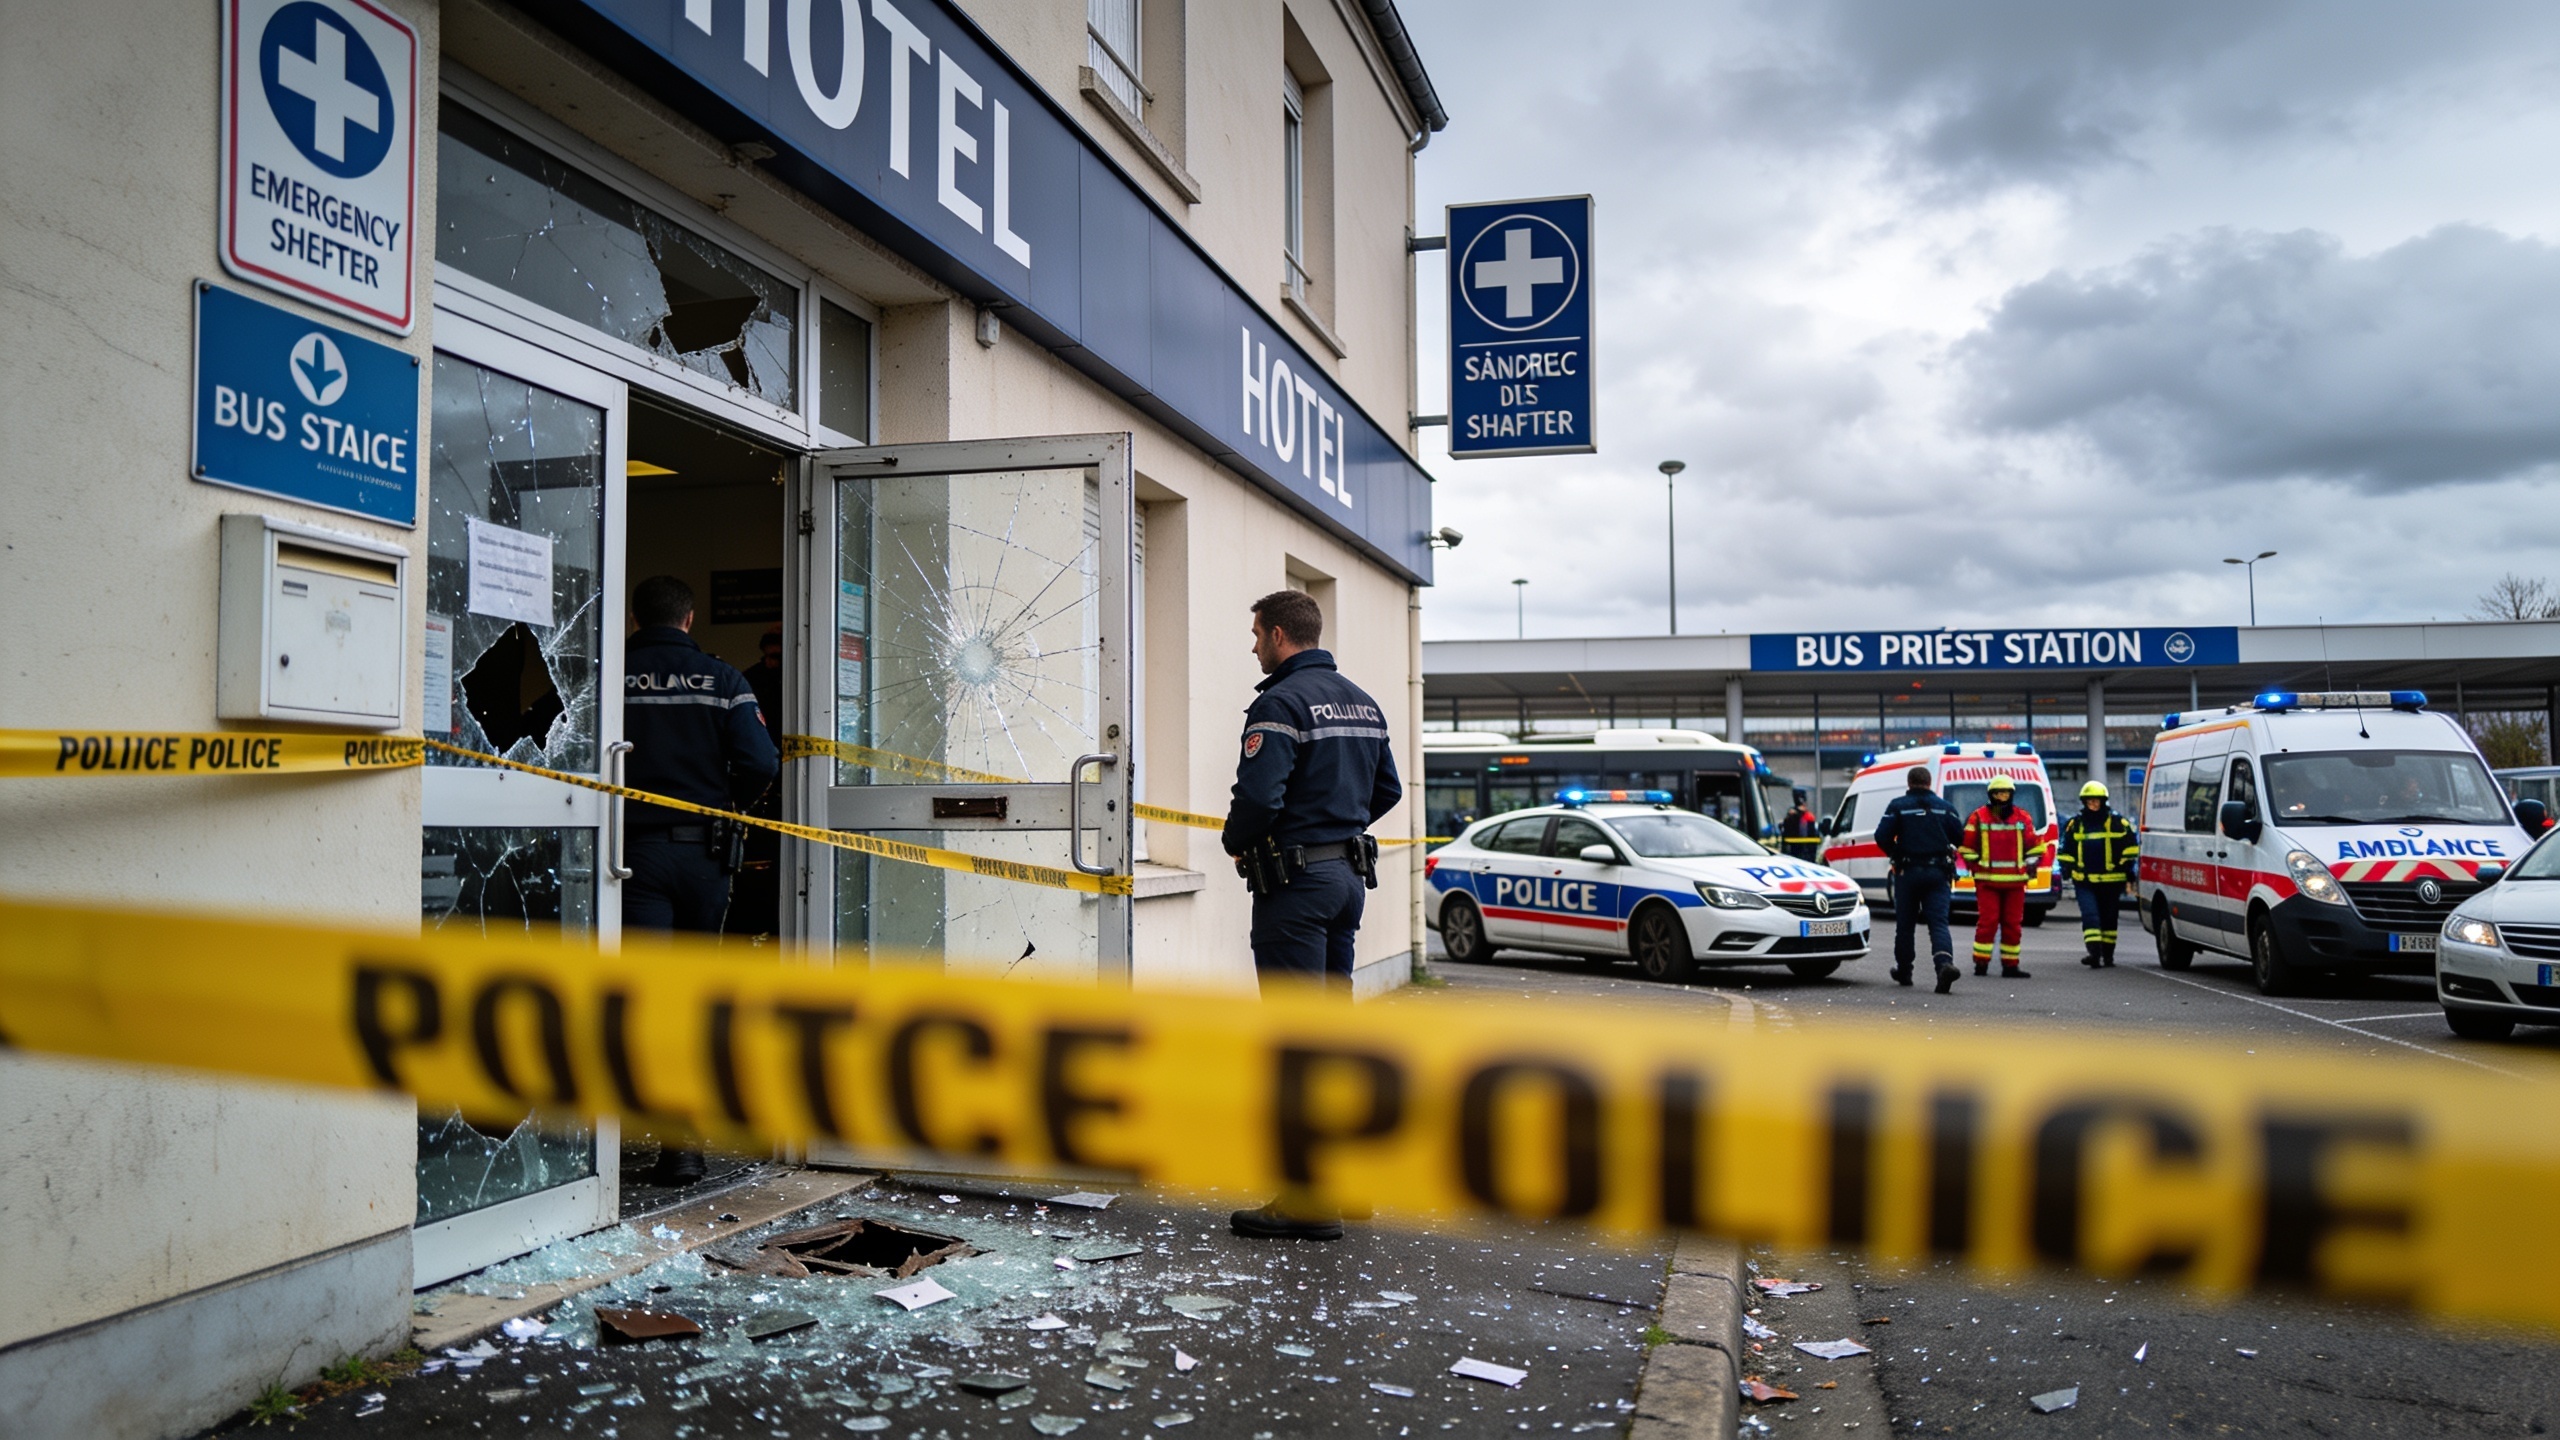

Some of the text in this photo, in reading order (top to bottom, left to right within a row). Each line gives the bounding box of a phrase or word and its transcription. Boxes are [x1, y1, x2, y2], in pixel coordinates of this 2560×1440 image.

[251, 162, 401, 252] EMERGENCY
[270, 217, 379, 289] SHEFTER
[214, 384, 407, 474] BUS STAICE
[1241, 324, 1353, 509] HOTEL
[1466, 410, 1574, 439] SHAFTER
[1796, 634, 1864, 667] BUS
[2003, 630, 2142, 664] STATION
[56, 736, 180, 771] POLIICE
[189, 738, 282, 770] POLICE
[1496, 877, 1598, 912] POLICE
[350, 955, 2428, 1298] POLITCE POLIICE
